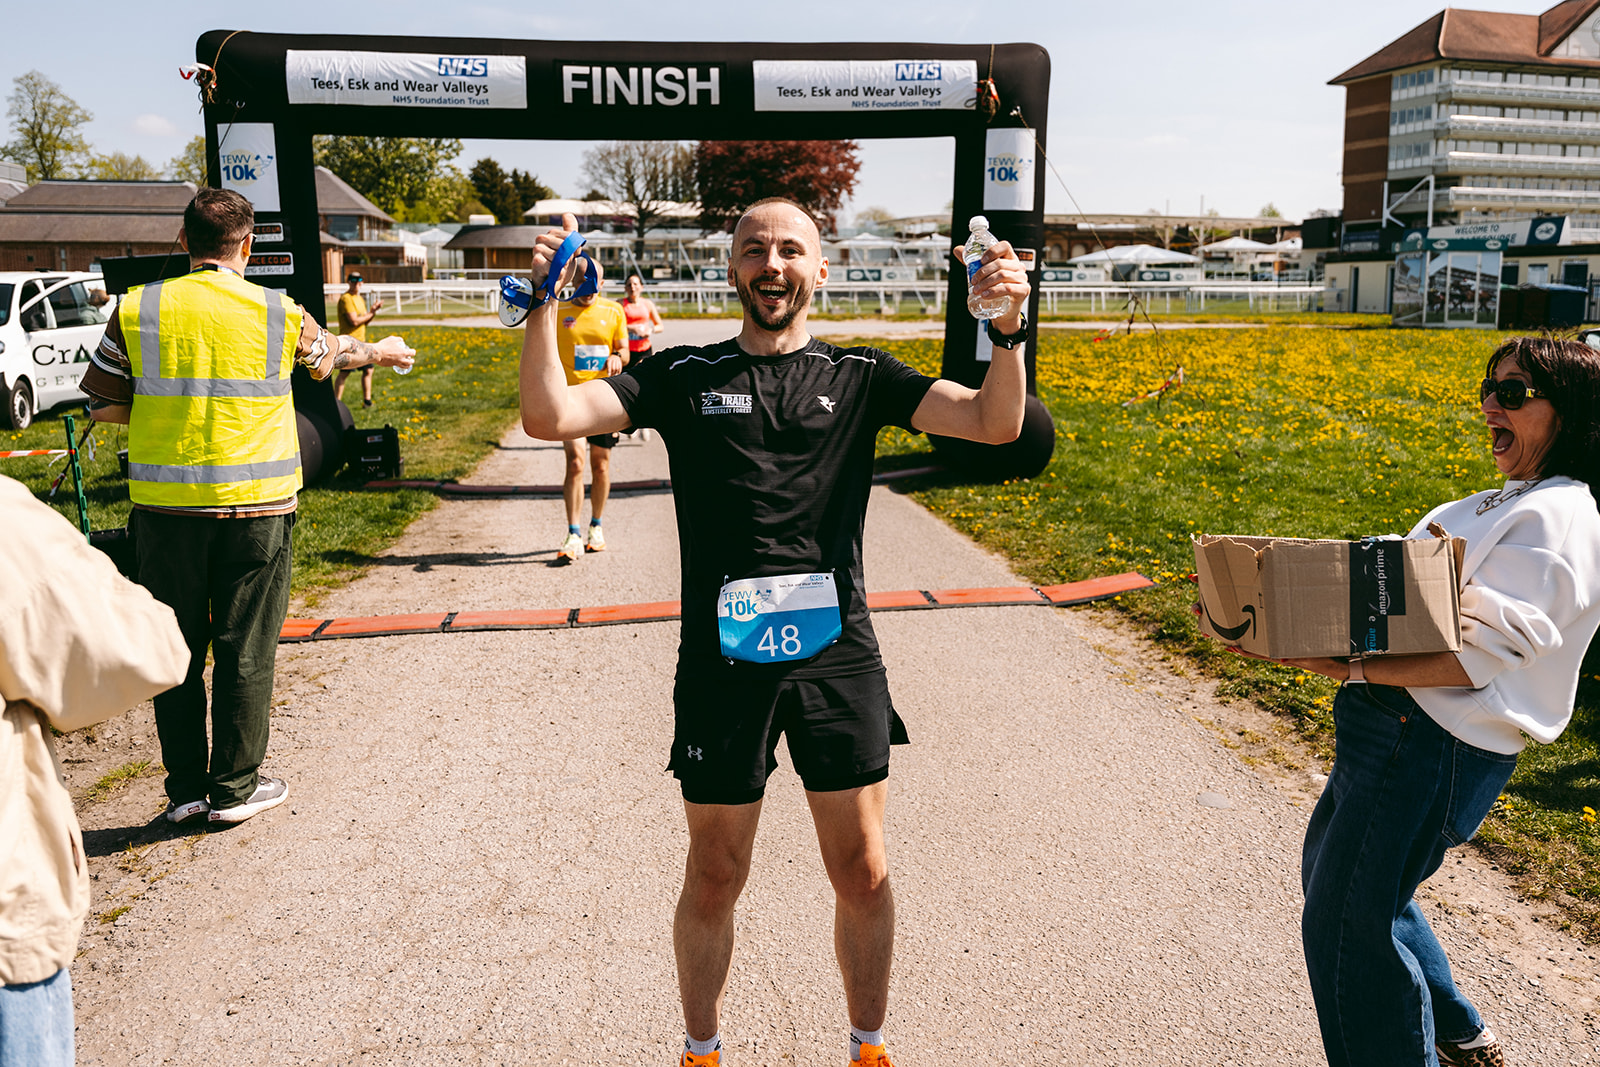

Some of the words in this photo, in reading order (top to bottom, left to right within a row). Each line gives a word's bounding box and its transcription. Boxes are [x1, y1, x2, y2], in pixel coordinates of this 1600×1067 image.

[439, 58, 487, 76] NHS
[896, 63, 941, 80] NHS
[311, 78, 343, 90] Tees,
[348, 78, 370, 90] Esk
[374, 79, 399, 91] and
[403, 80, 438, 92] Wear
[442, 81, 488, 96] Valleys
[562, 65, 720, 106] FINISH
[777, 86, 807, 98] Tees,
[811, 86, 831, 97] Esk
[835, 86, 859, 97] and
[862, 86, 895, 97] Wear
[899, 85, 941, 99] Valleys
[393, 95, 412, 104] NHS
[415, 96, 465, 105] Foundation
[468, 97, 490, 105] Trust
[852, 100, 870, 108] NHS
[872, 100, 919, 108] Foundation
[922, 99, 942, 107] Trust
[221, 154, 251, 164] TEWV
[988, 157, 1016, 166] TEWV
[223, 164, 257, 181] 10k
[988, 166, 1019, 182] 10k
[1455, 225, 1488, 234] WELCOME
[1490, 224, 1500, 232] TO
[586, 359, 599, 371] 12
[721, 395, 752, 406] TRAILS
[1375, 548, 1387, 579] prime
[723, 591, 752, 601] TEWV
[1379, 580, 1387, 615] amazon
[724, 599, 758, 616] 10k
[757, 624, 802, 657] 48
